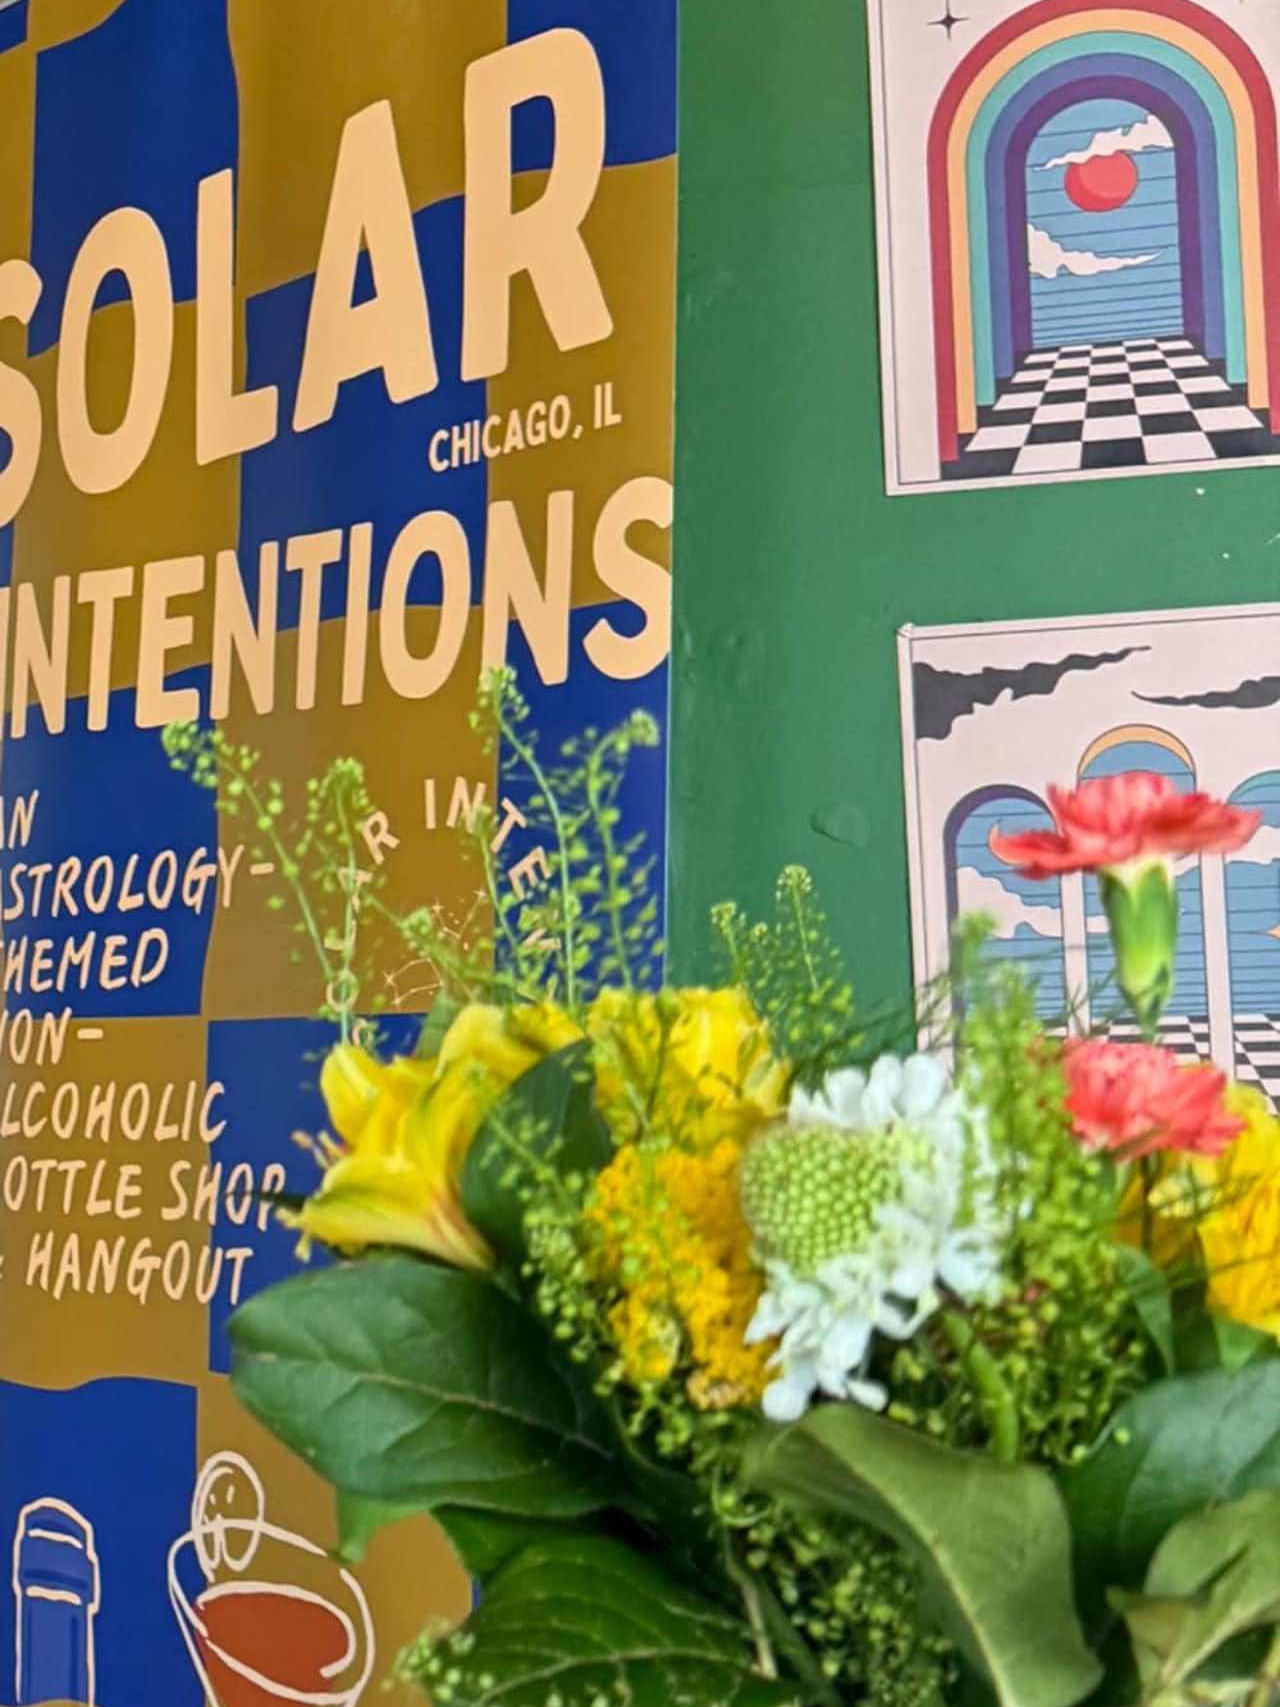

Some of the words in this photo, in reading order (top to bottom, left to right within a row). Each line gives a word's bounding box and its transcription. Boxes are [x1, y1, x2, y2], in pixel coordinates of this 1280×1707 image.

[428, 392, 584, 473] CHICAGO,
[593, 383, 622, 428] IL
[162, 1161, 287, 1232] SHOP
[26, 1230, 254, 1305] HANGOUT
